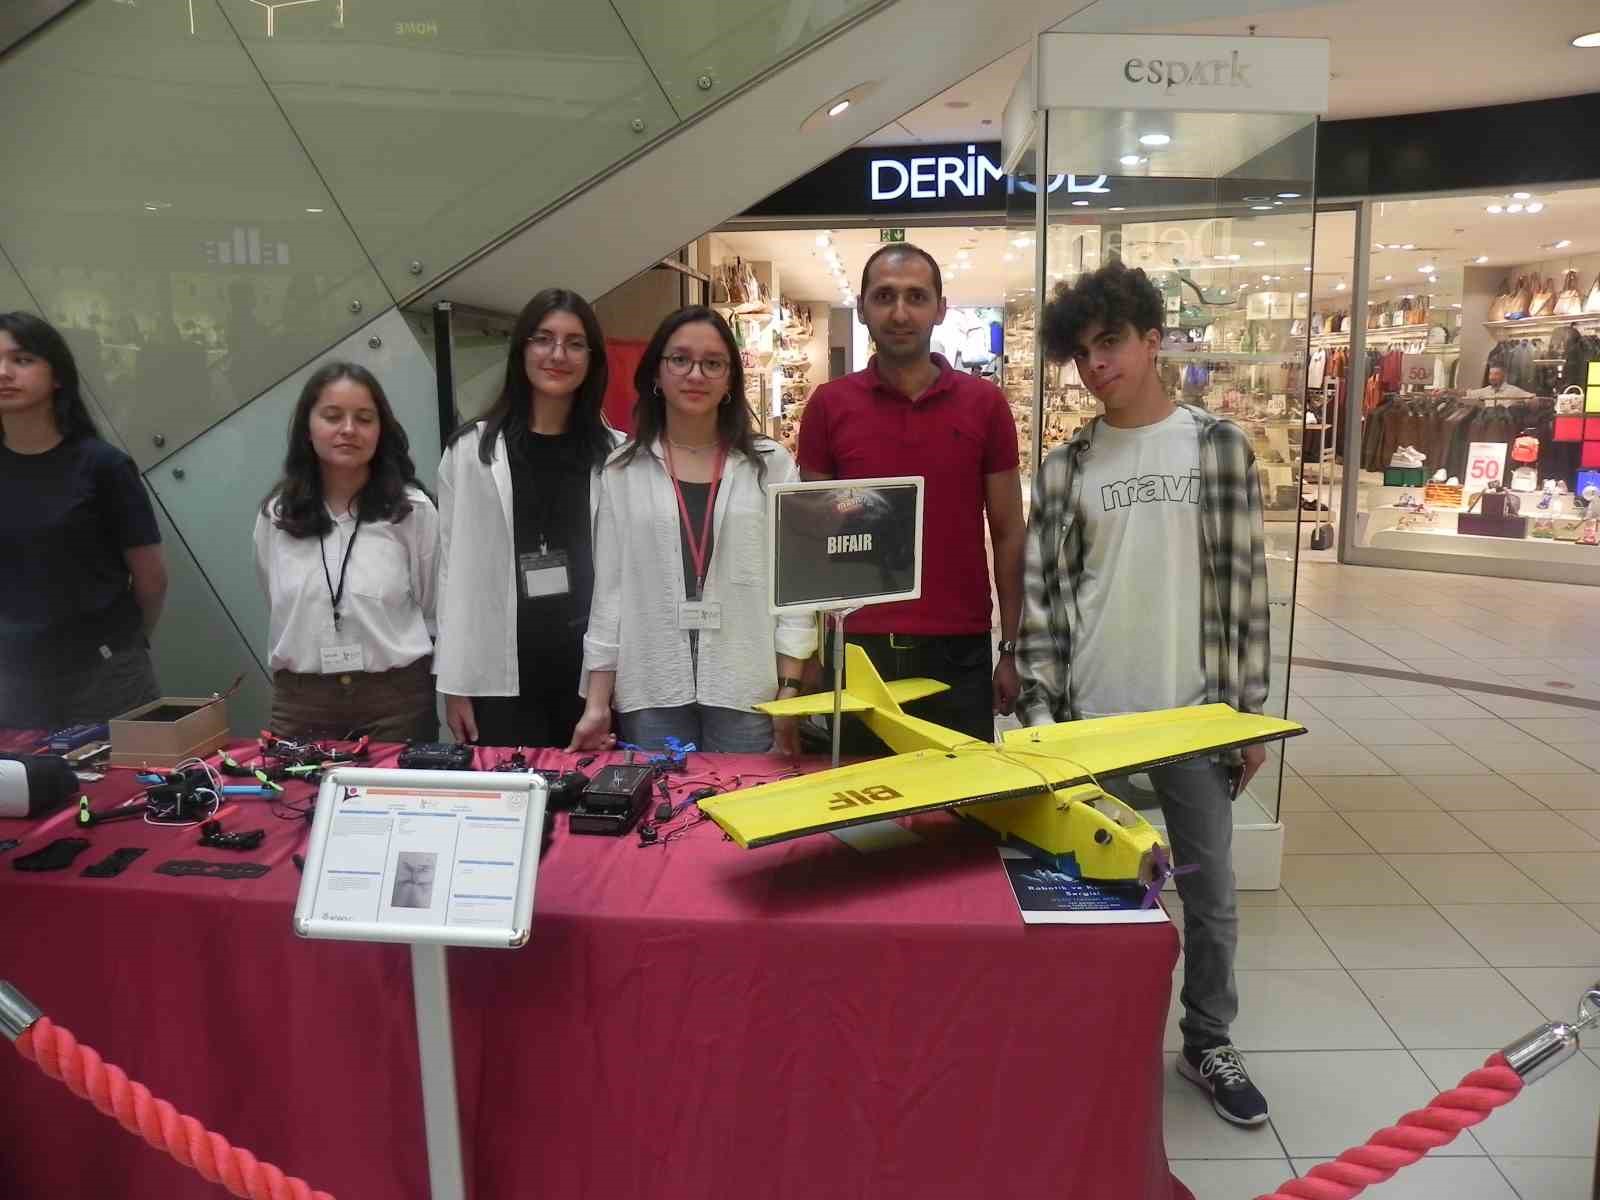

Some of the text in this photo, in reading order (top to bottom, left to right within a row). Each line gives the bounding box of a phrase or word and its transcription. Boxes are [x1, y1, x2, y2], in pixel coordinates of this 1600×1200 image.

[1124, 50, 1253, 96] espark
[1471, 460, 1500, 480] 50
[1101, 468, 1200, 512] mavi
[828, 533, 873, 554] BIFAIR
